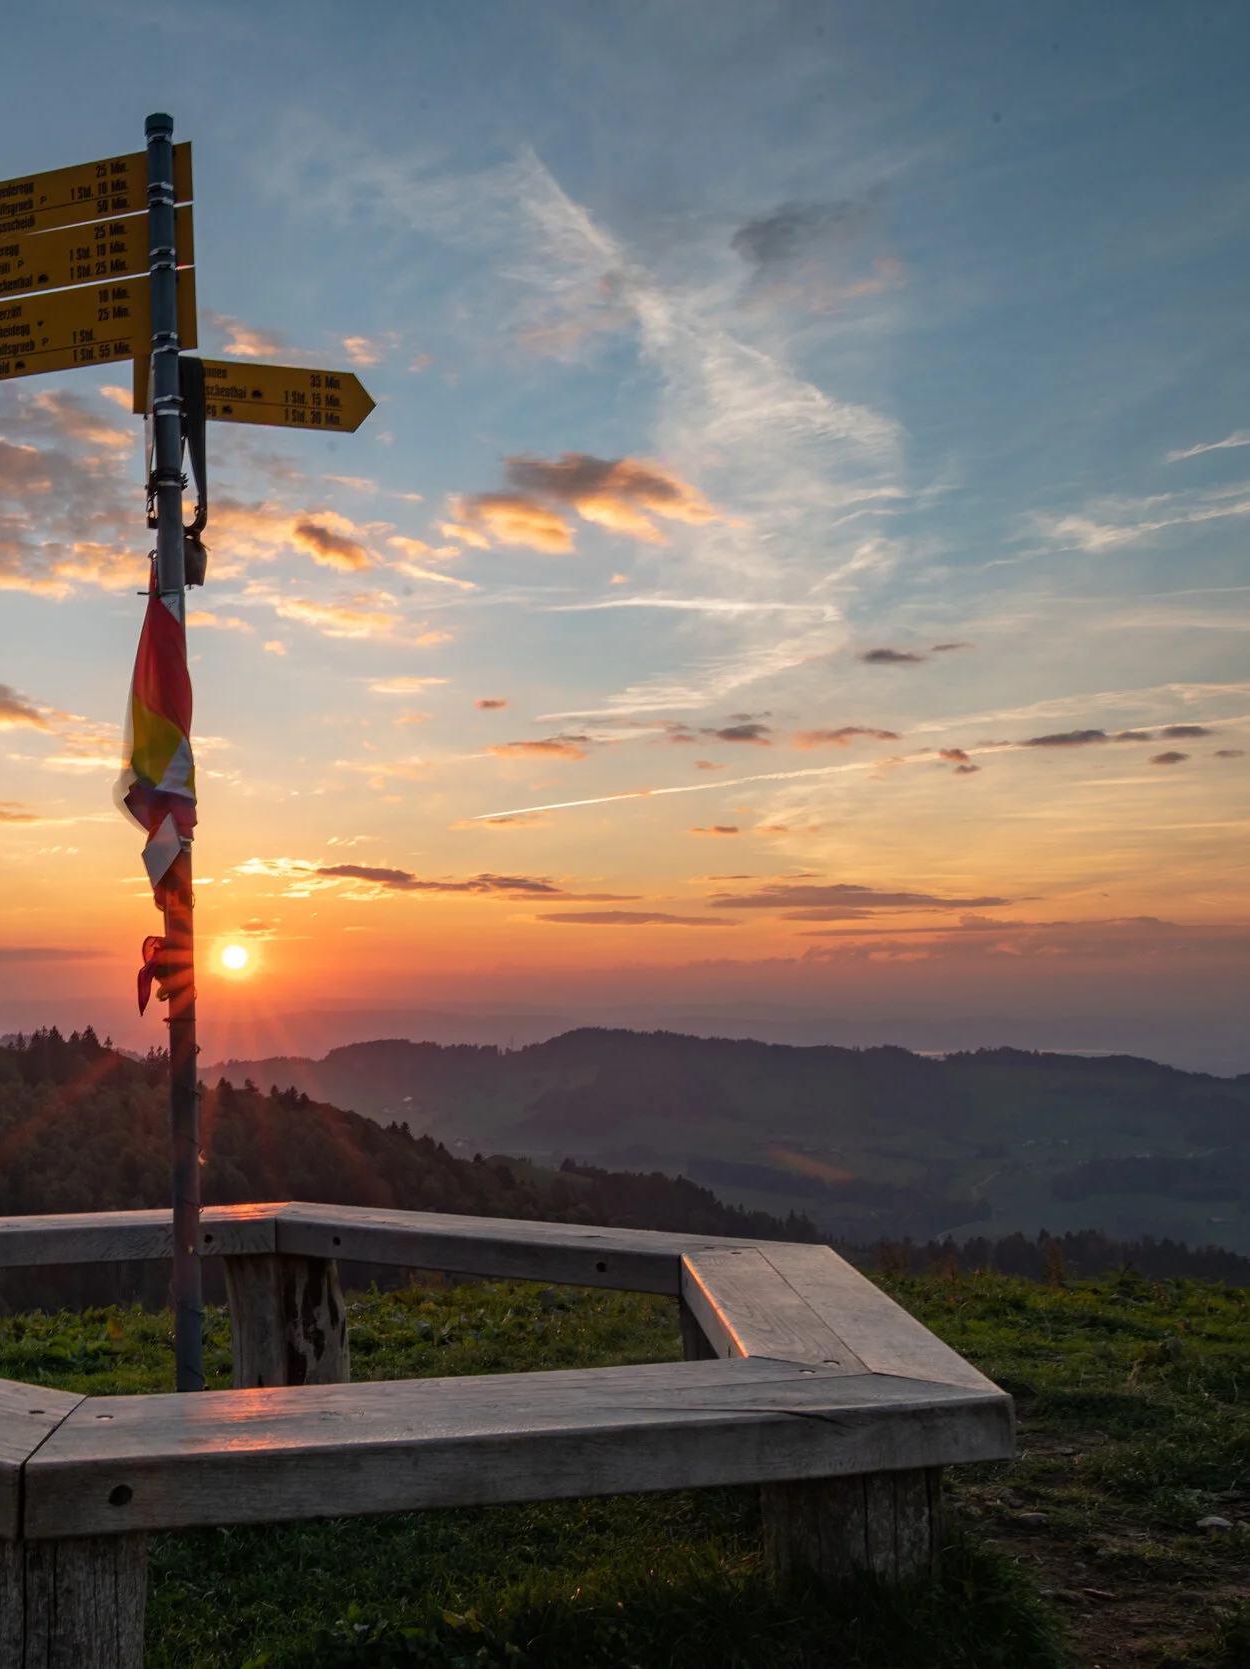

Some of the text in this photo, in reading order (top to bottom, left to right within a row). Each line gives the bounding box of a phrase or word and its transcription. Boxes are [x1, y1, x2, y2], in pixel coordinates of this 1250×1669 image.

[96, 164, 106, 178] 25
[110, 160, 128, 174] Min.
[70, 188, 75, 200] 1
[78, 185, 94, 199] Std.
[98, 181, 107, 195] 10
[111, 180, 129, 192] Min.
[97, 199, 108, 213] 50
[112, 196, 130, 209] Min.
[94, 225, 106, 239] 25
[110, 222, 127, 236] Min.
[69, 249, 74, 262] 1
[76, 246, 92, 260] Std.
[97, 244, 106, 257] 10
[110, 241, 128, 254] Min.
[70, 267, 74, 280] 1
[77, 264, 93, 279] Std.
[95, 260, 107, 275] 25
[110, 258, 129, 272] Min.
[99, 289, 108, 303] 10
[112, 287, 130, 301] Min.
[98, 307, 110, 321] 25
[113, 306, 130, 319] Min.
[72, 331, 77, 344] 1
[80, 328, 95, 342] Std.
[73, 349, 77, 362] 1
[80, 347, 96, 361] Std.
[99, 344, 110, 358] 55
[114, 342, 132, 356] Min.
[310, 374, 321, 388] 35
[325, 376, 342, 389] Min.
[205, 385, 342, 408] schenthal 1 Std. 15 Min.
[205, 404, 217, 416] eg
[285, 408, 288, 421] 1
[291, 408, 307, 423] Std.
[325, 412, 342, 426] Min.
